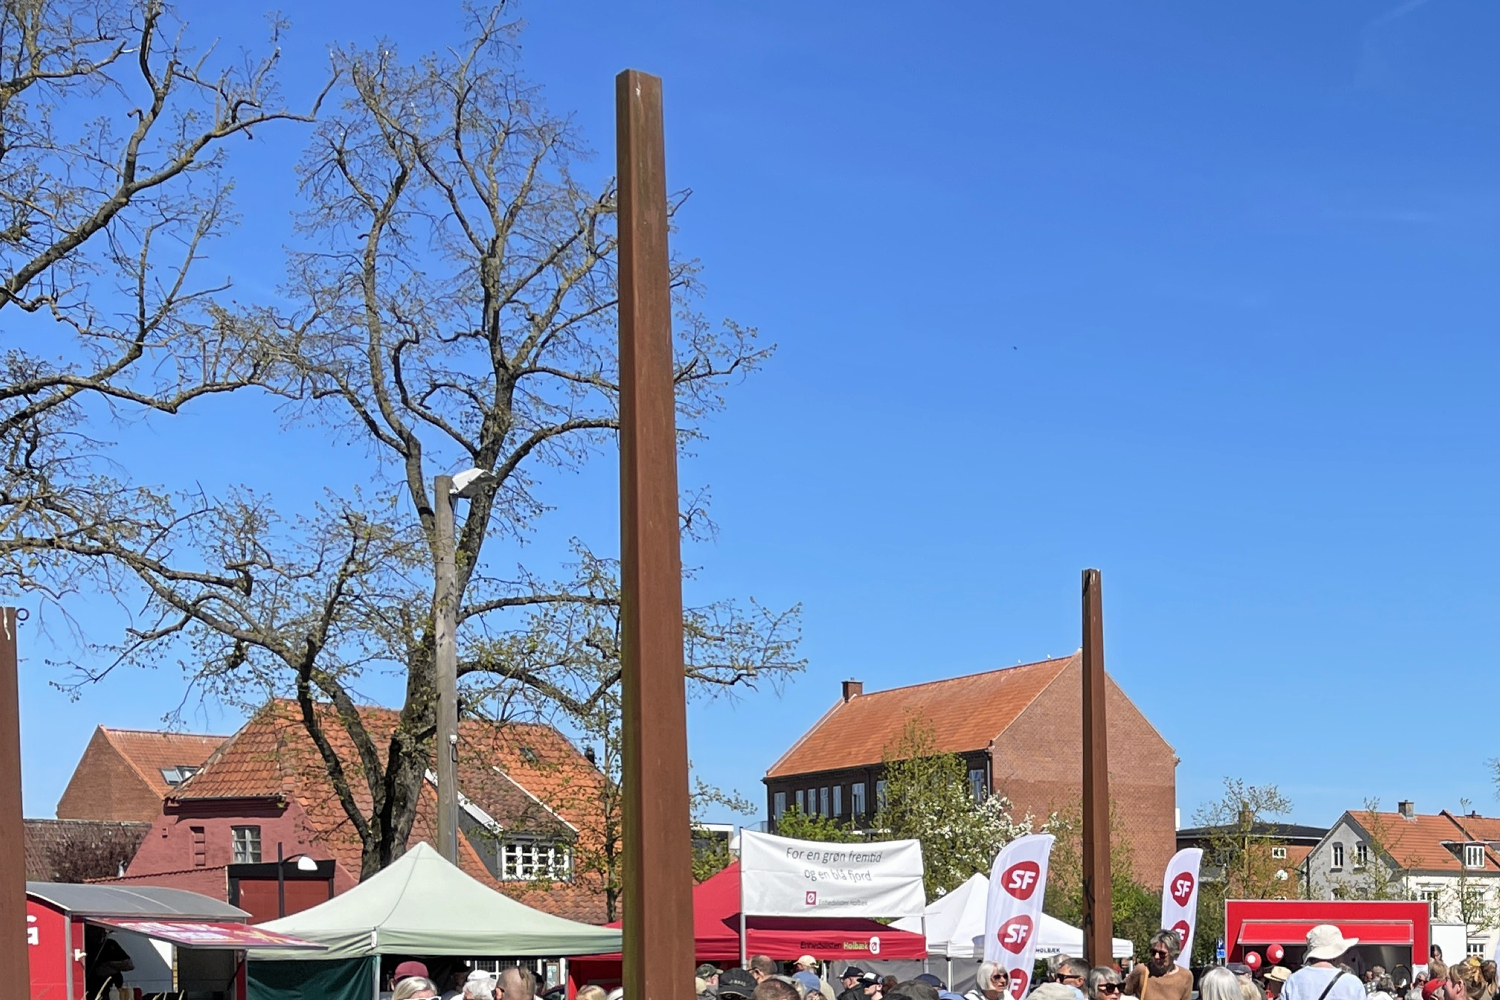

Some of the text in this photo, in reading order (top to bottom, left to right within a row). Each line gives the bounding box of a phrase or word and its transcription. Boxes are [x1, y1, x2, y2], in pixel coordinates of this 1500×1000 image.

[786, 847, 883, 864] For en grøn fremtid
[804, 869, 872, 883] og en blå fjord
[1008, 869, 1036, 890] SF
[1174, 880, 1192, 898] SF
[1004, 924, 1029, 944] SF
[843, 941, 868, 950] Holbæk
